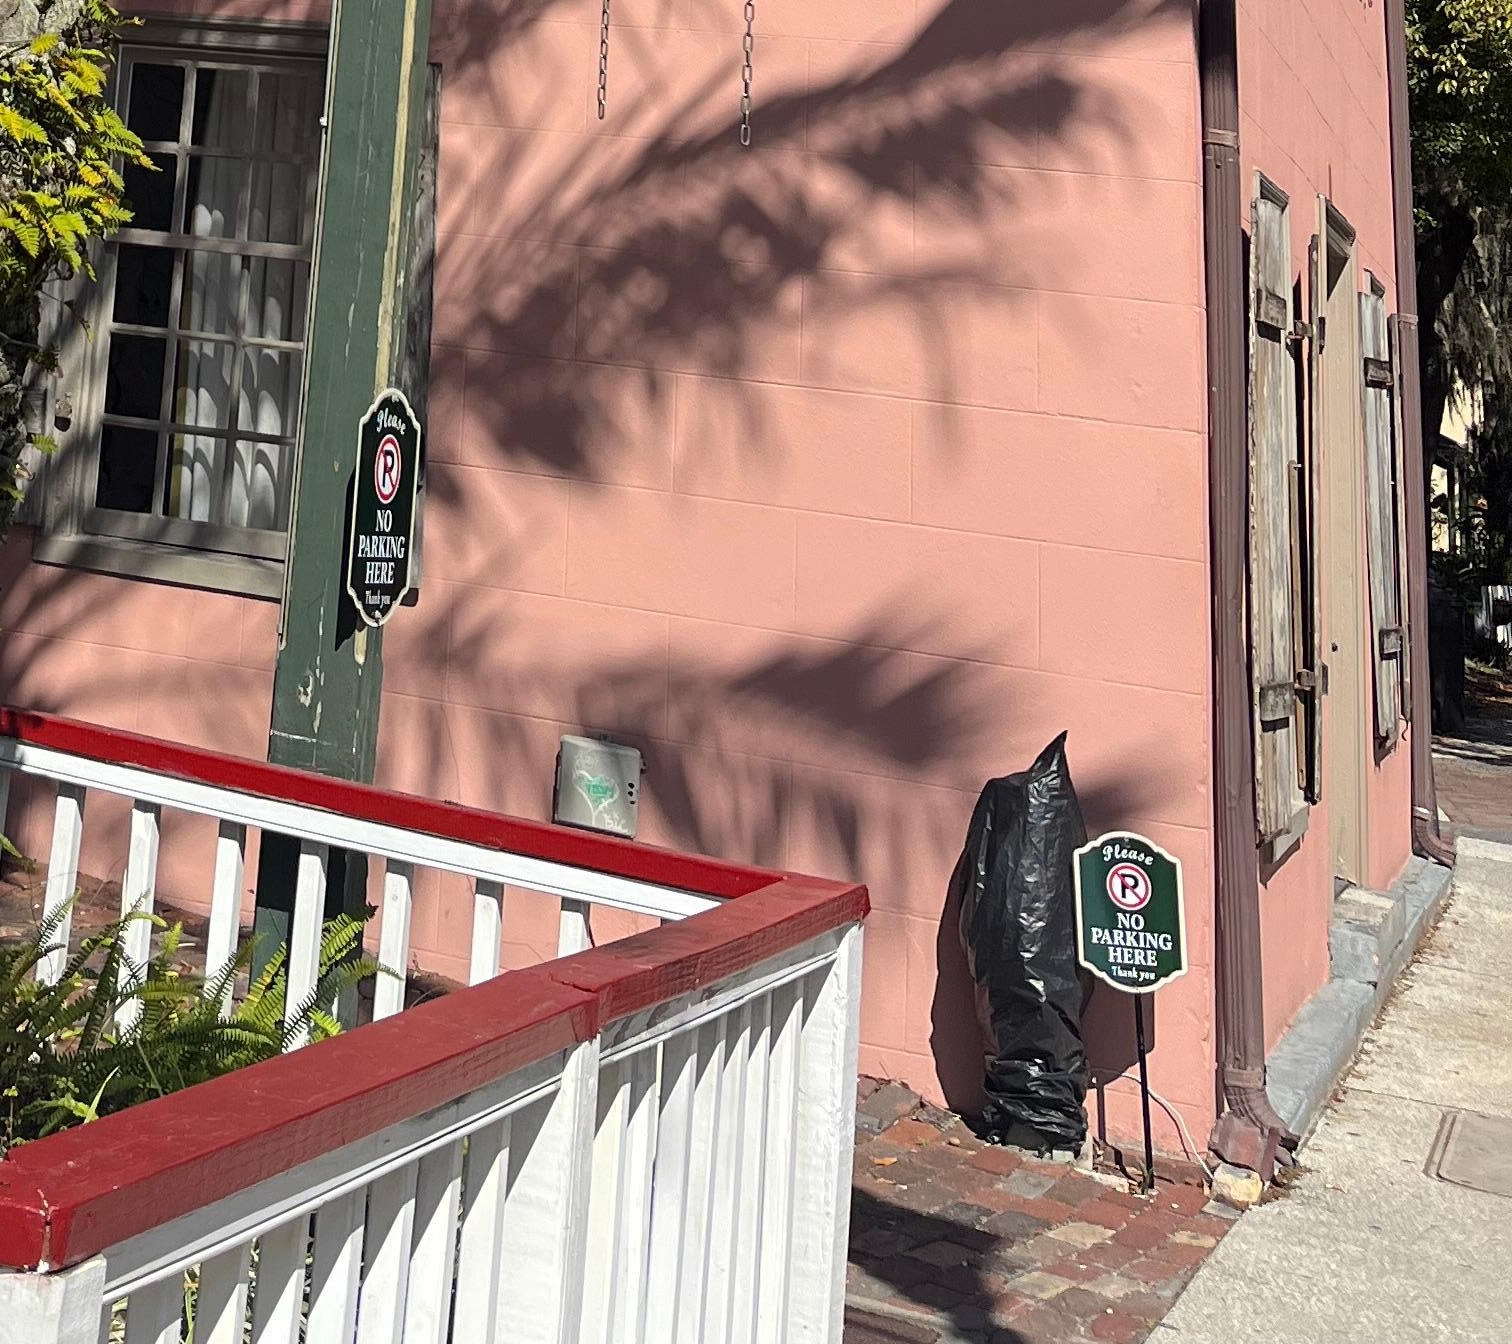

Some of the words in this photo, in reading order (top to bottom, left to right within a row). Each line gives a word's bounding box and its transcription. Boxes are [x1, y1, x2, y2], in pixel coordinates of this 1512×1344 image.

[375, 509, 393, 532] NO
[357, 534, 406, 559] PARKING
[364, 561, 395, 585] HERE
[365, 589, 381, 605] Thank
[380, 595, 391, 609] you
[1102, 844, 1155, 866] Please
[1117, 912, 1145, 930] NO
[1091, 927, 1173, 951] PARKING
[1107, 946, 1158, 967] HERE
[1111, 965, 1139, 980] Thank
[1137, 969, 1156, 982] you
